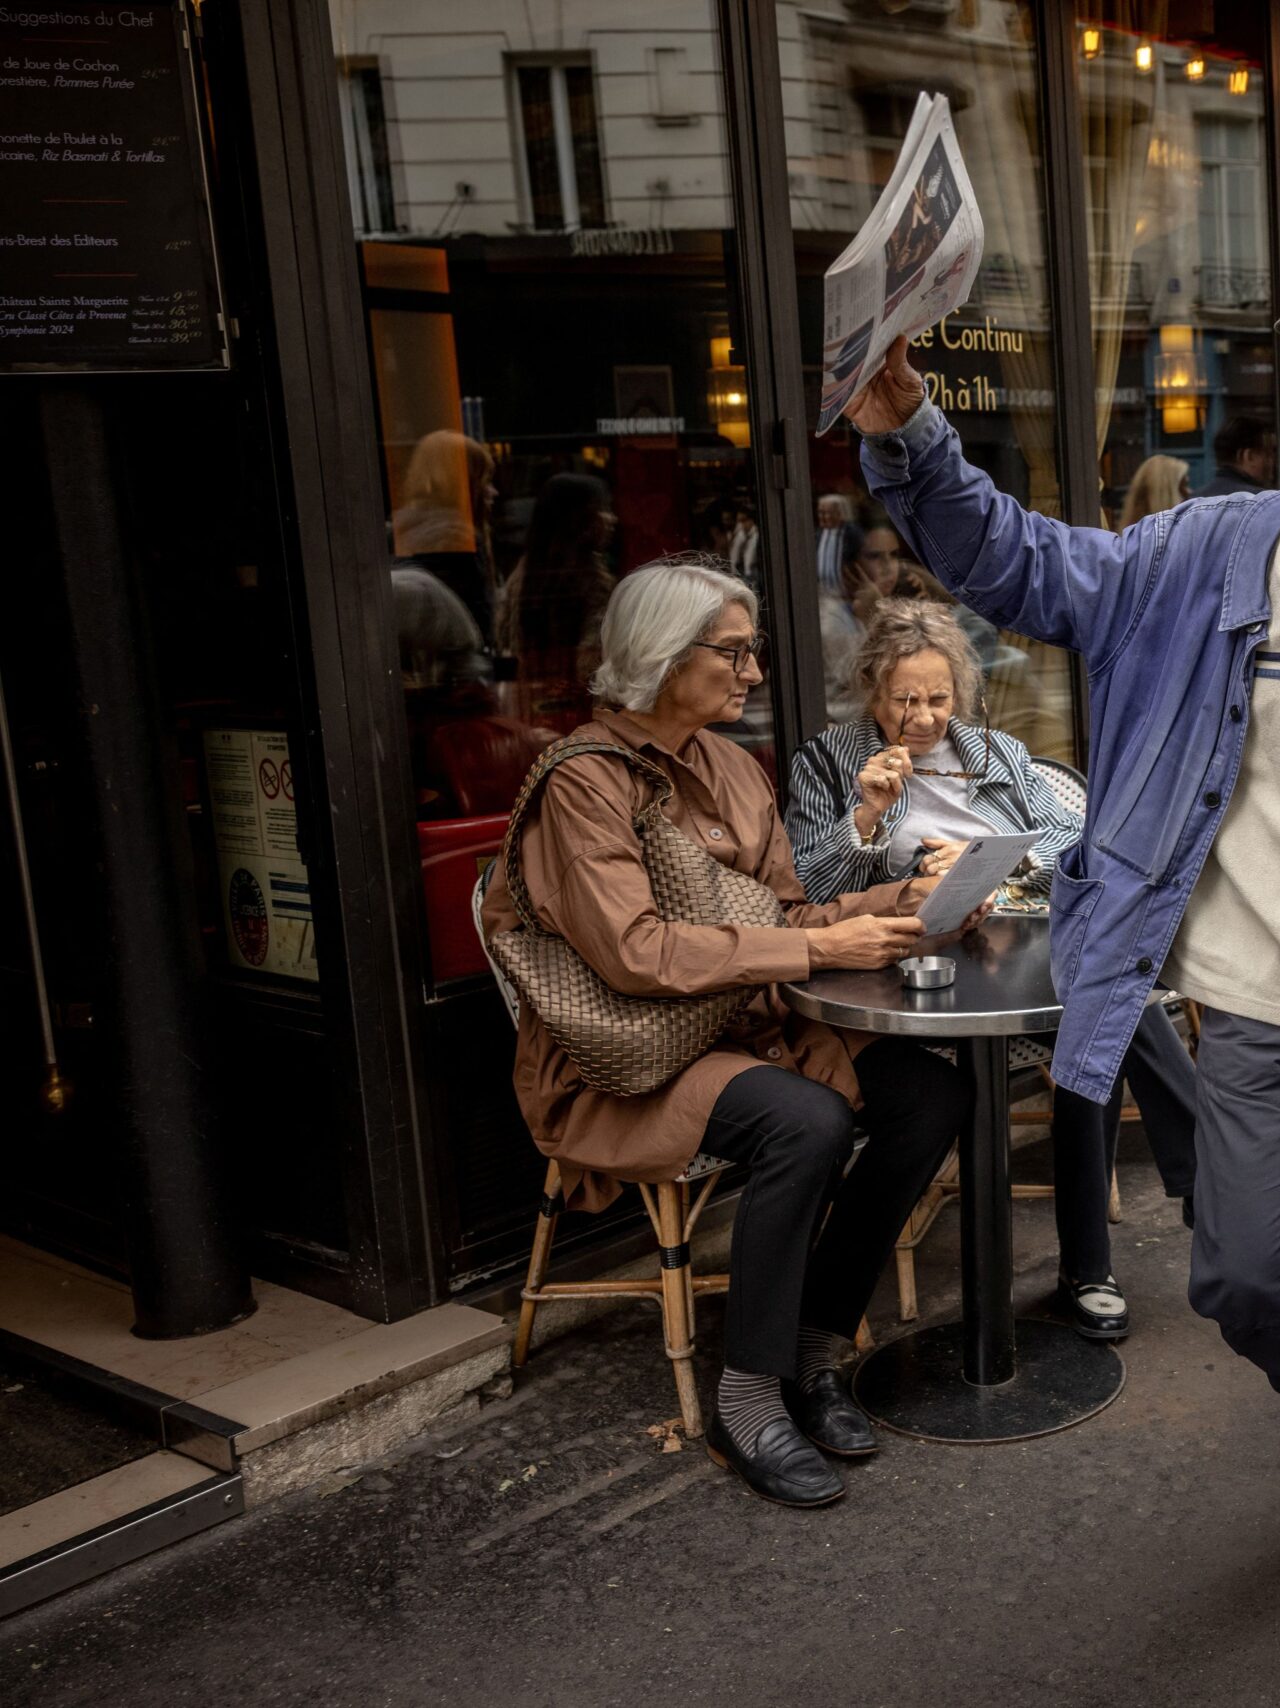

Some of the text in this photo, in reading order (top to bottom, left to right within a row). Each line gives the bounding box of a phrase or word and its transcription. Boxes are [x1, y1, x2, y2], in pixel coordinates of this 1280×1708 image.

[0, 7, 154, 27] Suggestions du Chef
[3, 57, 120, 72] de Joue de Cochon
[54, 75, 99, 89] Pommes
[102, 76, 136, 89] Purée
[44, 132, 61, 144] de
[63, 132, 97, 145] Poulet
[100, 133, 109, 145] à
[111, 133, 124, 146] la
[42, 149, 60, 161] Riz
[62, 150, 109, 161] Basmati
[111, 150, 121, 161] &
[125, 150, 166, 163] Tortillas
[0, 234, 119, 247] ris-Brest des Editeurs
[39, 296, 71, 306] Sainte
[73, 296, 129, 308] Marguerite
[18, 310, 48, 320] Classé
[49, 310, 74, 320] Côtes
[76, 310, 86, 320] de
[89, 310, 128, 320] Provence
[0, 324, 75, 338] Symphonie 2024
[940, 308, 1024, 353] Continu
[957, 378, 971, 410] à
[973, 375, 997, 411] 1h
